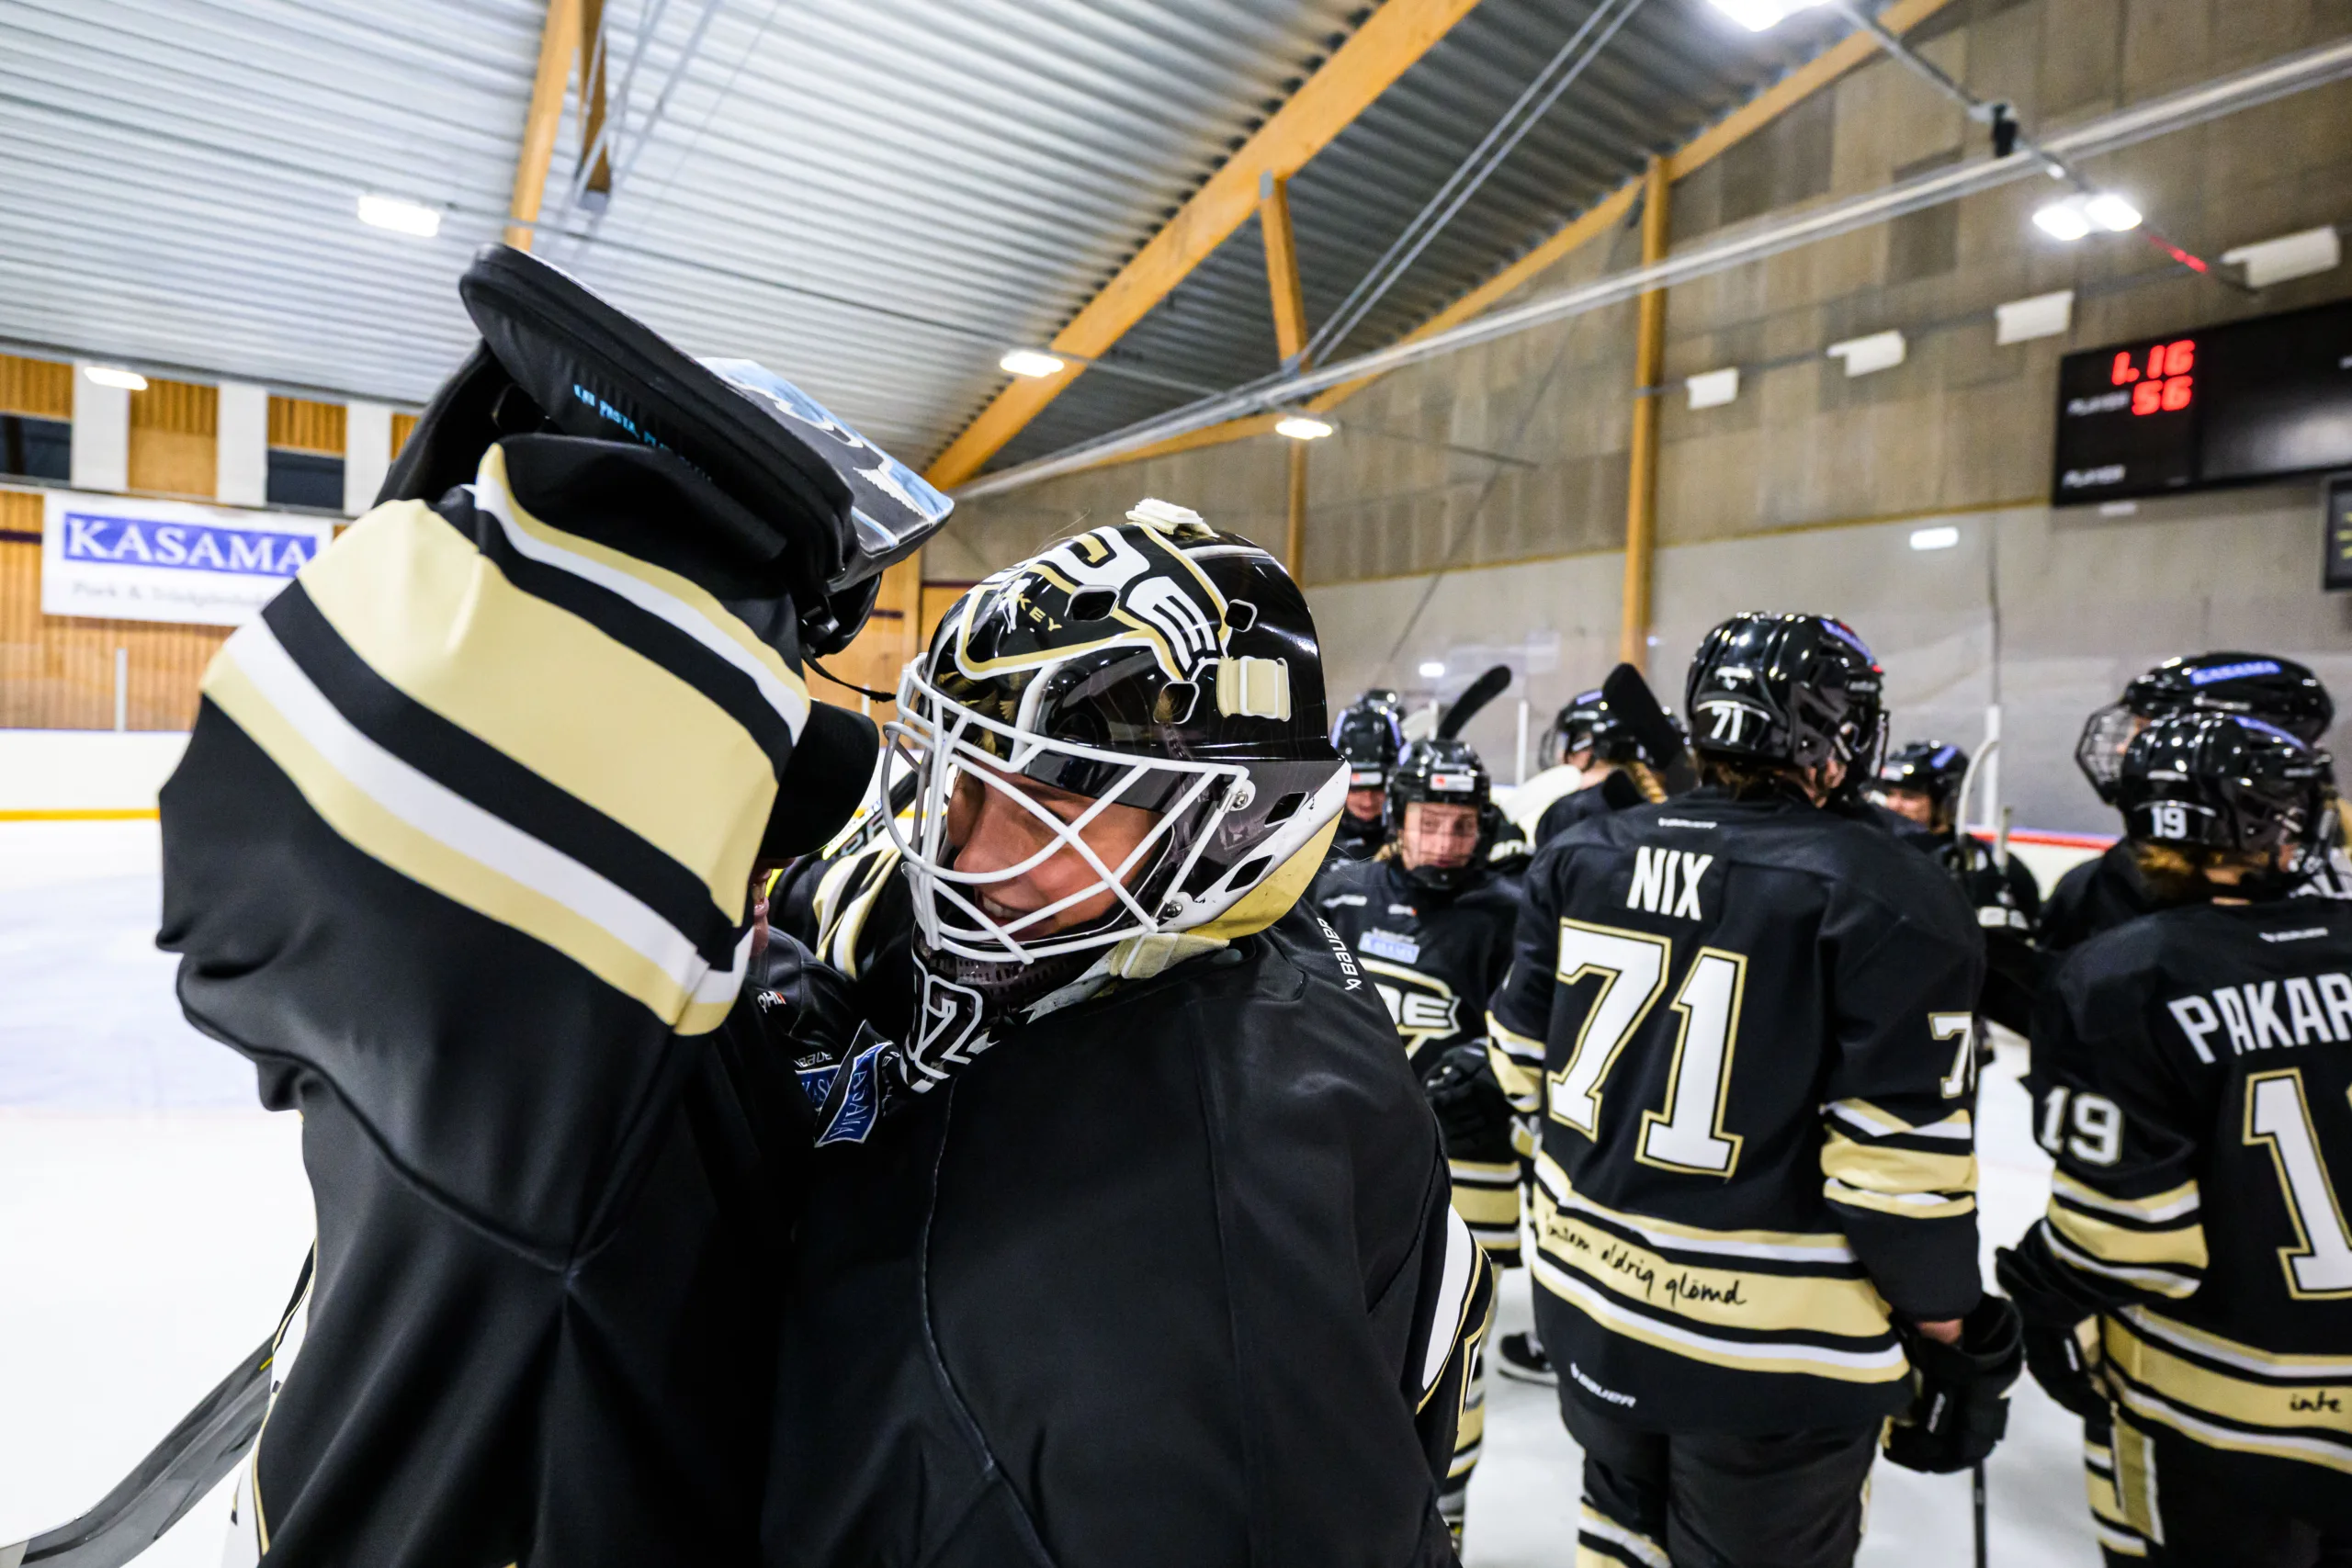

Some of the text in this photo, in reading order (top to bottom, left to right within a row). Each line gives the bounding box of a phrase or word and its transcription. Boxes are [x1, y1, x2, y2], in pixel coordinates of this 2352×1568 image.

[69, 518, 309, 574] KASAMA
[1711, 706, 1743, 742] 71
[2151, 807, 2187, 839] 19
[1626, 845, 1713, 920] NIX
[1547, 918, 1747, 1178] 71
[1928, 1012, 1975, 1098] 7
[2167, 972, 2352, 1063] PAKAR
[2040, 1087, 2123, 1168] 19
[2243, 1067, 2352, 1300] 1
[1665, 1273, 1746, 1306] glömd
